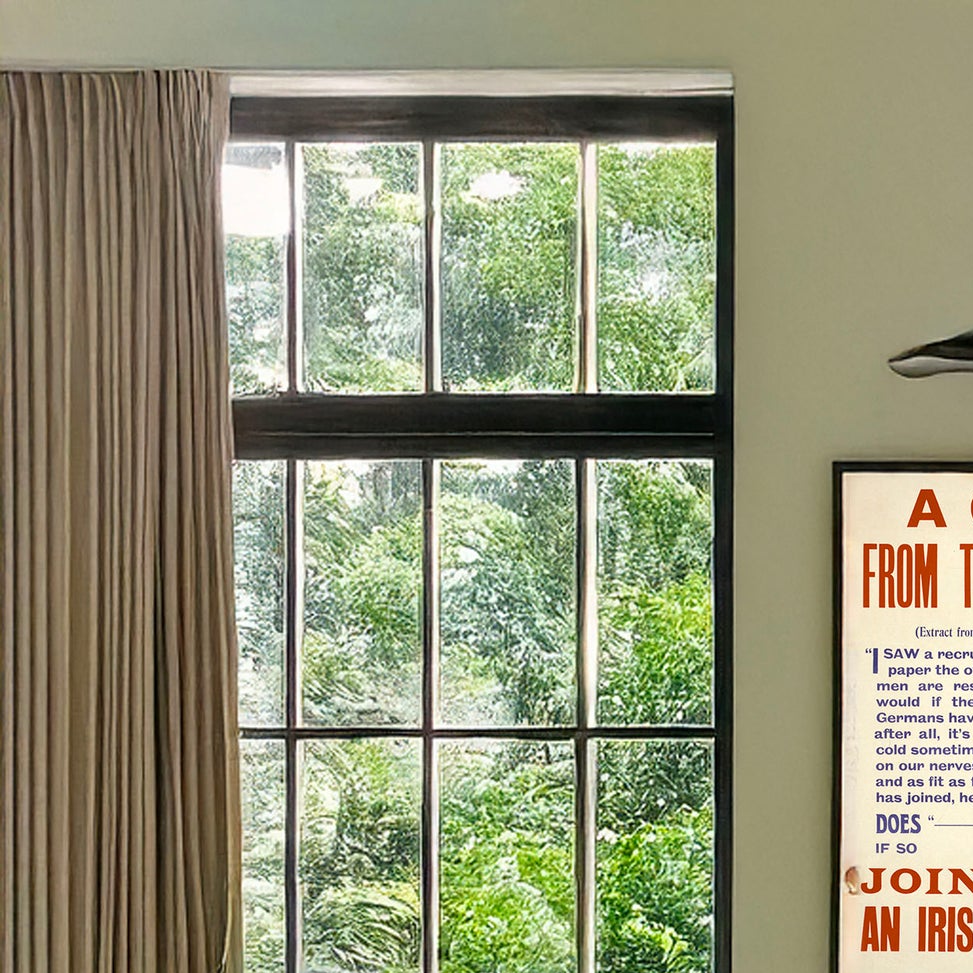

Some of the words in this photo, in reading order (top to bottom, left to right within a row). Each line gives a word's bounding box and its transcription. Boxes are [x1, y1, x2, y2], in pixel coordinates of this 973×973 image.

[907, 489, 947, 527] A
[863, 543, 937, 608] FROM
[916, 626, 952, 639] (Extract
[884, 647, 919, 660] SAW
[925, 650, 933, 660] a
[889, 666, 931, 678] paper
[935, 664, 959, 676] the
[877, 682, 908, 692] men
[919, 682, 943, 692] are
[876, 696, 919, 708] would
[932, 695, 942, 708] if
[877, 711, 944, 724] Germans
[875, 727, 911, 740] after
[919, 728, 940, 741] all,
[876, 743, 906, 756] cold
[876, 762, 893, 772] on
[899, 762, 924, 772] our
[876, 776, 902, 788] and
[907, 778, 924, 788] as
[929, 775, 944, 787] fit
[949, 778, 965, 788] as
[876, 791, 902, 804] has
[905, 792, 954, 805] joined,
[876, 814, 921, 833] DOES
[876, 842, 890, 854] IF
[897, 842, 917, 855] SO
[861, 906, 900, 952] AN
